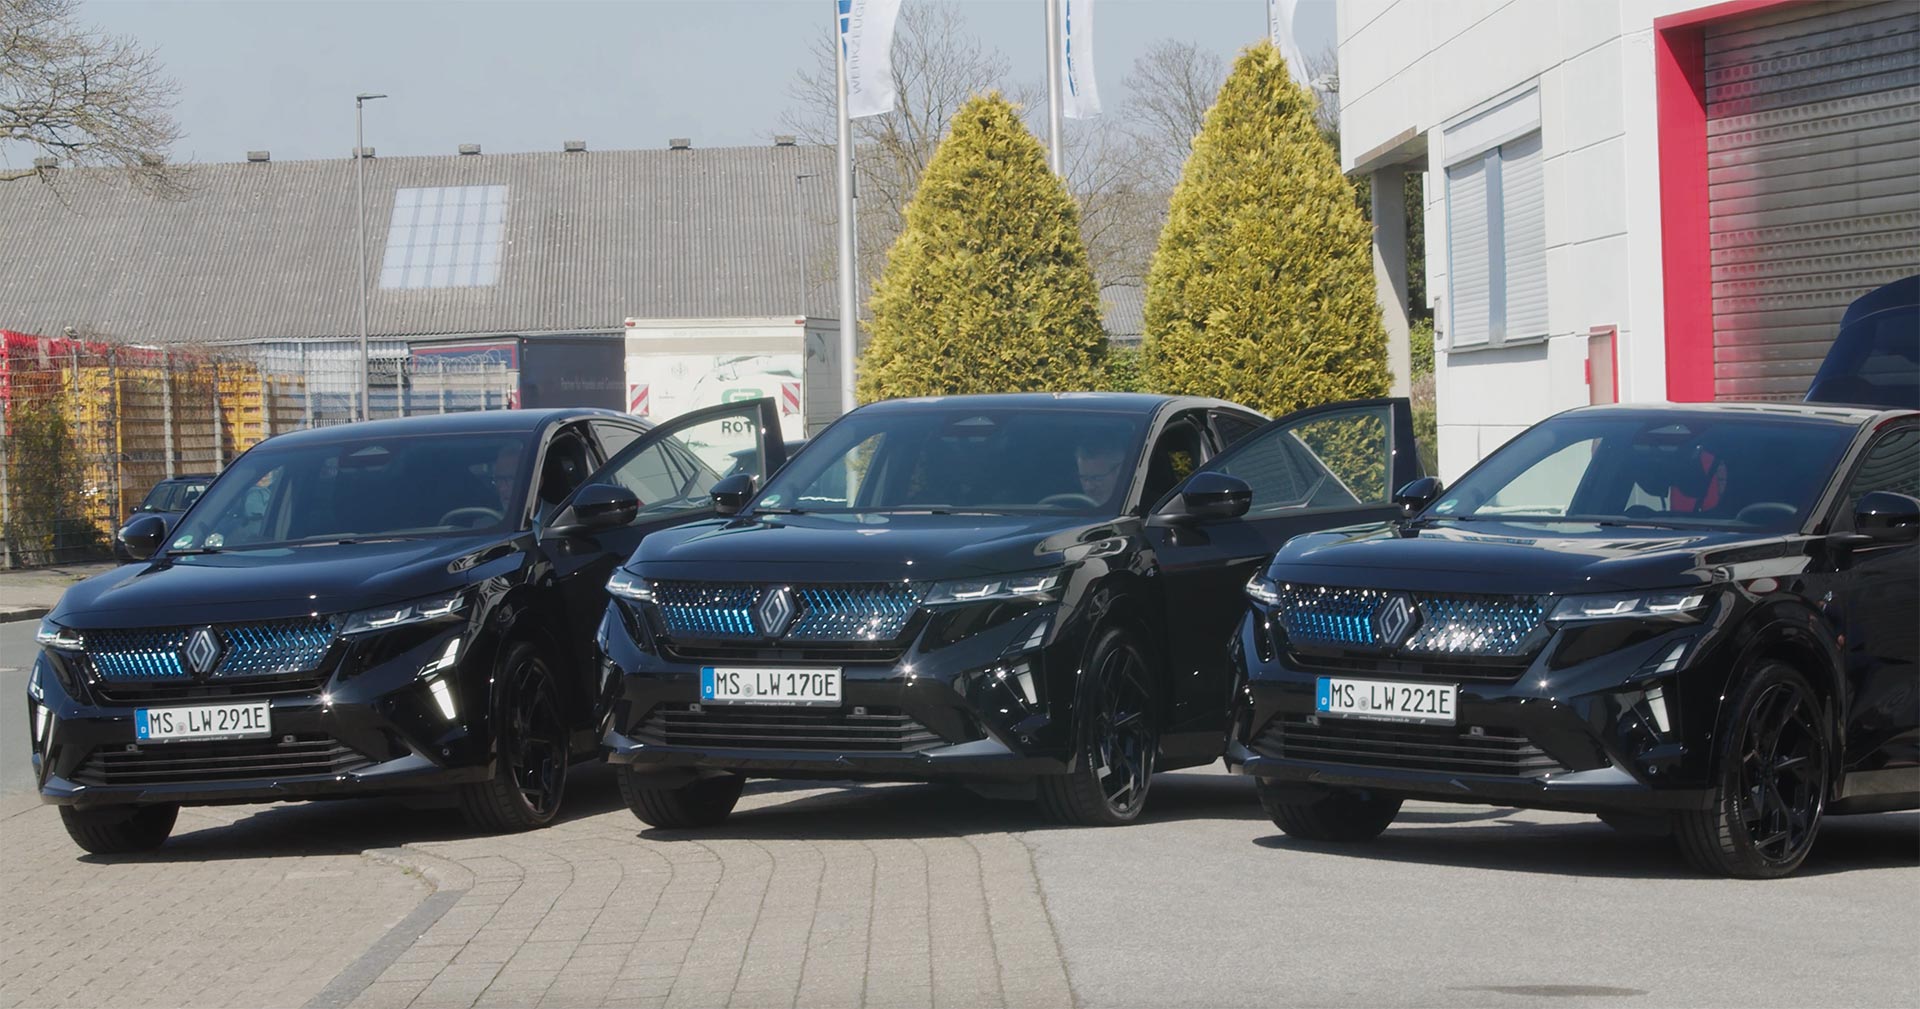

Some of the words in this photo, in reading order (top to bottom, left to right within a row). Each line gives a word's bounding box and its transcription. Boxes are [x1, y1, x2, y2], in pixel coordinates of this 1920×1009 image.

[716, 673, 740, 695] MS
[756, 673, 781, 696] LW
[786, 673, 837, 697] 170E
[1331, 684, 1355, 708] MS
[1371, 686, 1395, 711] LW
[1401, 688, 1451, 714] 221E
[150, 712, 174, 734] MS
[188, 710, 213, 732] LW
[217, 707, 266, 731] 291E
